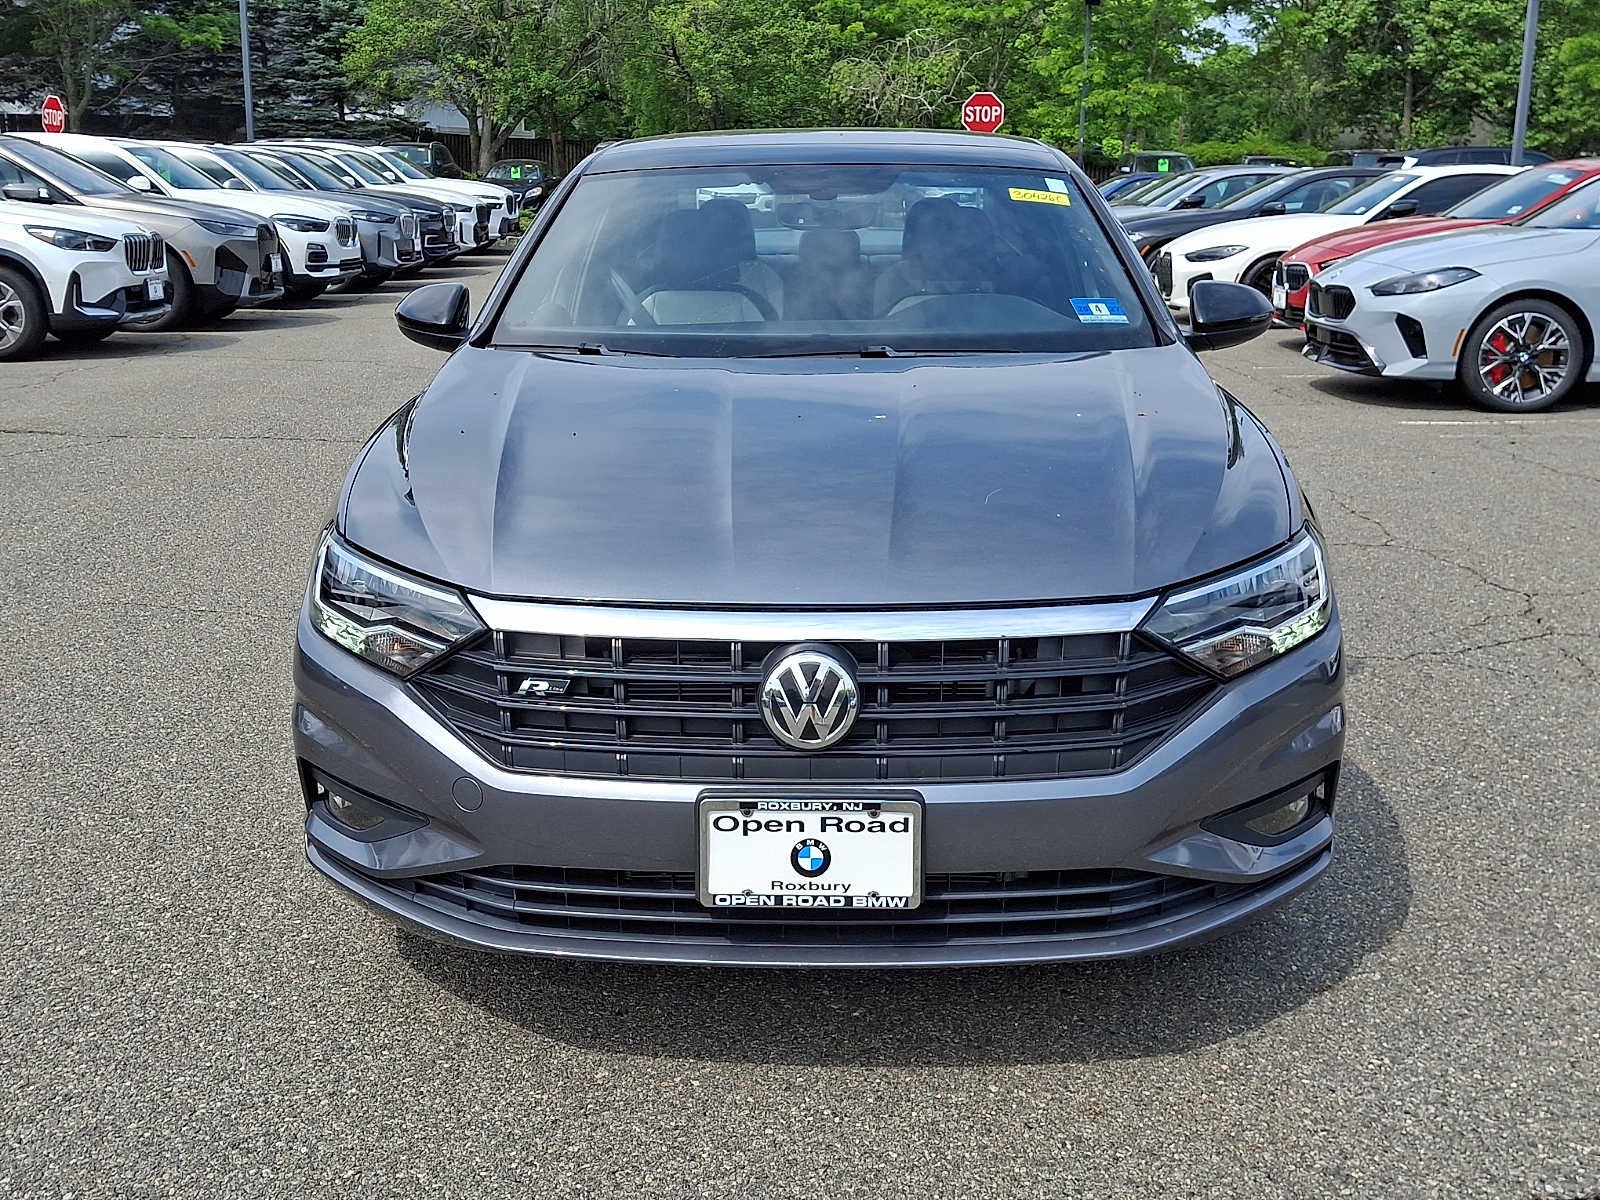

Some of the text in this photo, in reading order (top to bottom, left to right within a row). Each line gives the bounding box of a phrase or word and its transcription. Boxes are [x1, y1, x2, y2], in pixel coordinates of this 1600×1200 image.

[44, 108, 62, 126] STOP
[965, 105, 1001, 122] STOP
[757, 801, 864, 811] ROXBURY, NJ
[712, 815, 910, 837] Open Road
[795, 839, 829, 851] BMW
[770, 881, 852, 893] Roxbury
[714, 894, 909, 908] OPEN ROAD BMW
